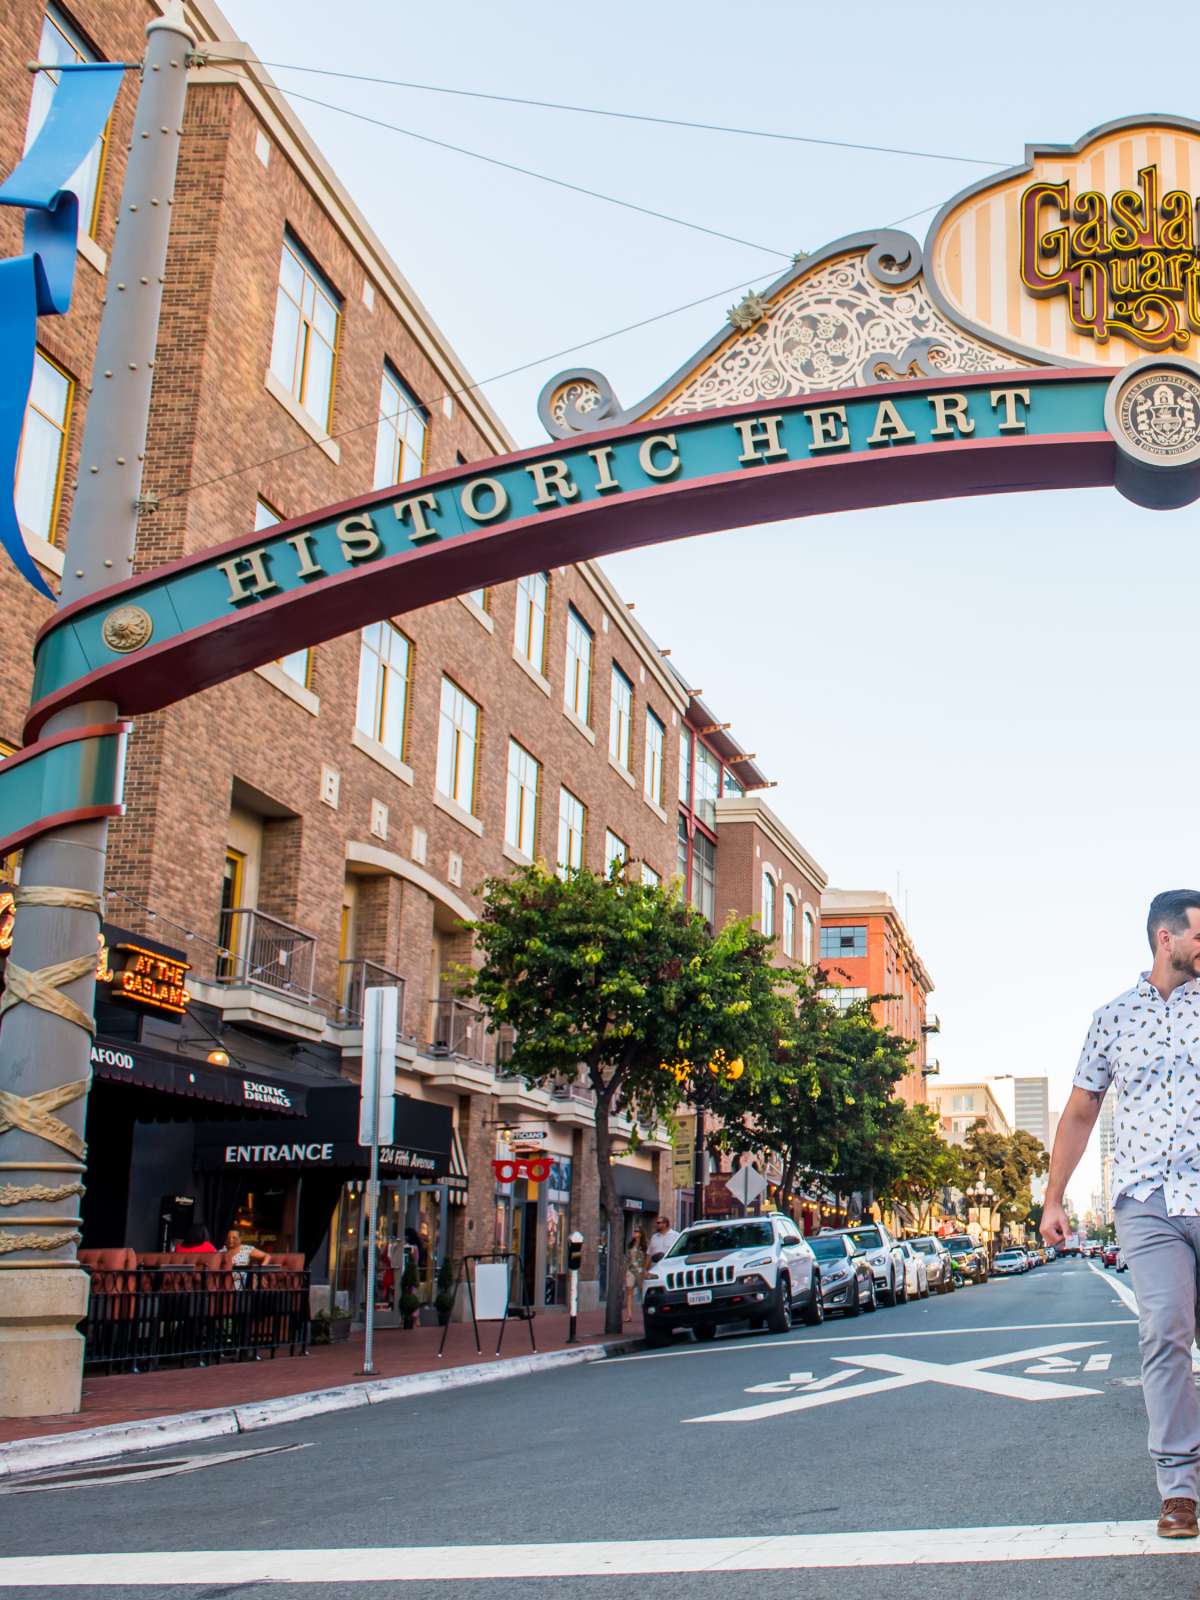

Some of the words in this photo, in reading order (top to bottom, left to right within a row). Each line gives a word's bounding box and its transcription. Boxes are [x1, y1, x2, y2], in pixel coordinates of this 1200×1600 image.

[217, 433, 681, 604] HISTORIC
[733, 388, 1030, 463] HEART
[135, 955, 155, 974] AT
[156, 962, 184, 986] THE
[123, 971, 191, 1007] GASLAMP
[243, 1080, 287, 1099] EXOTIC
[244, 1090, 292, 1108] DRINKS
[226, 1143, 334, 1163] ENTRANCE
[379, 1147, 394, 1164] 224
[394, 1150, 410, 1167] Fifth
[410, 1153, 435, 1170] Avenue
